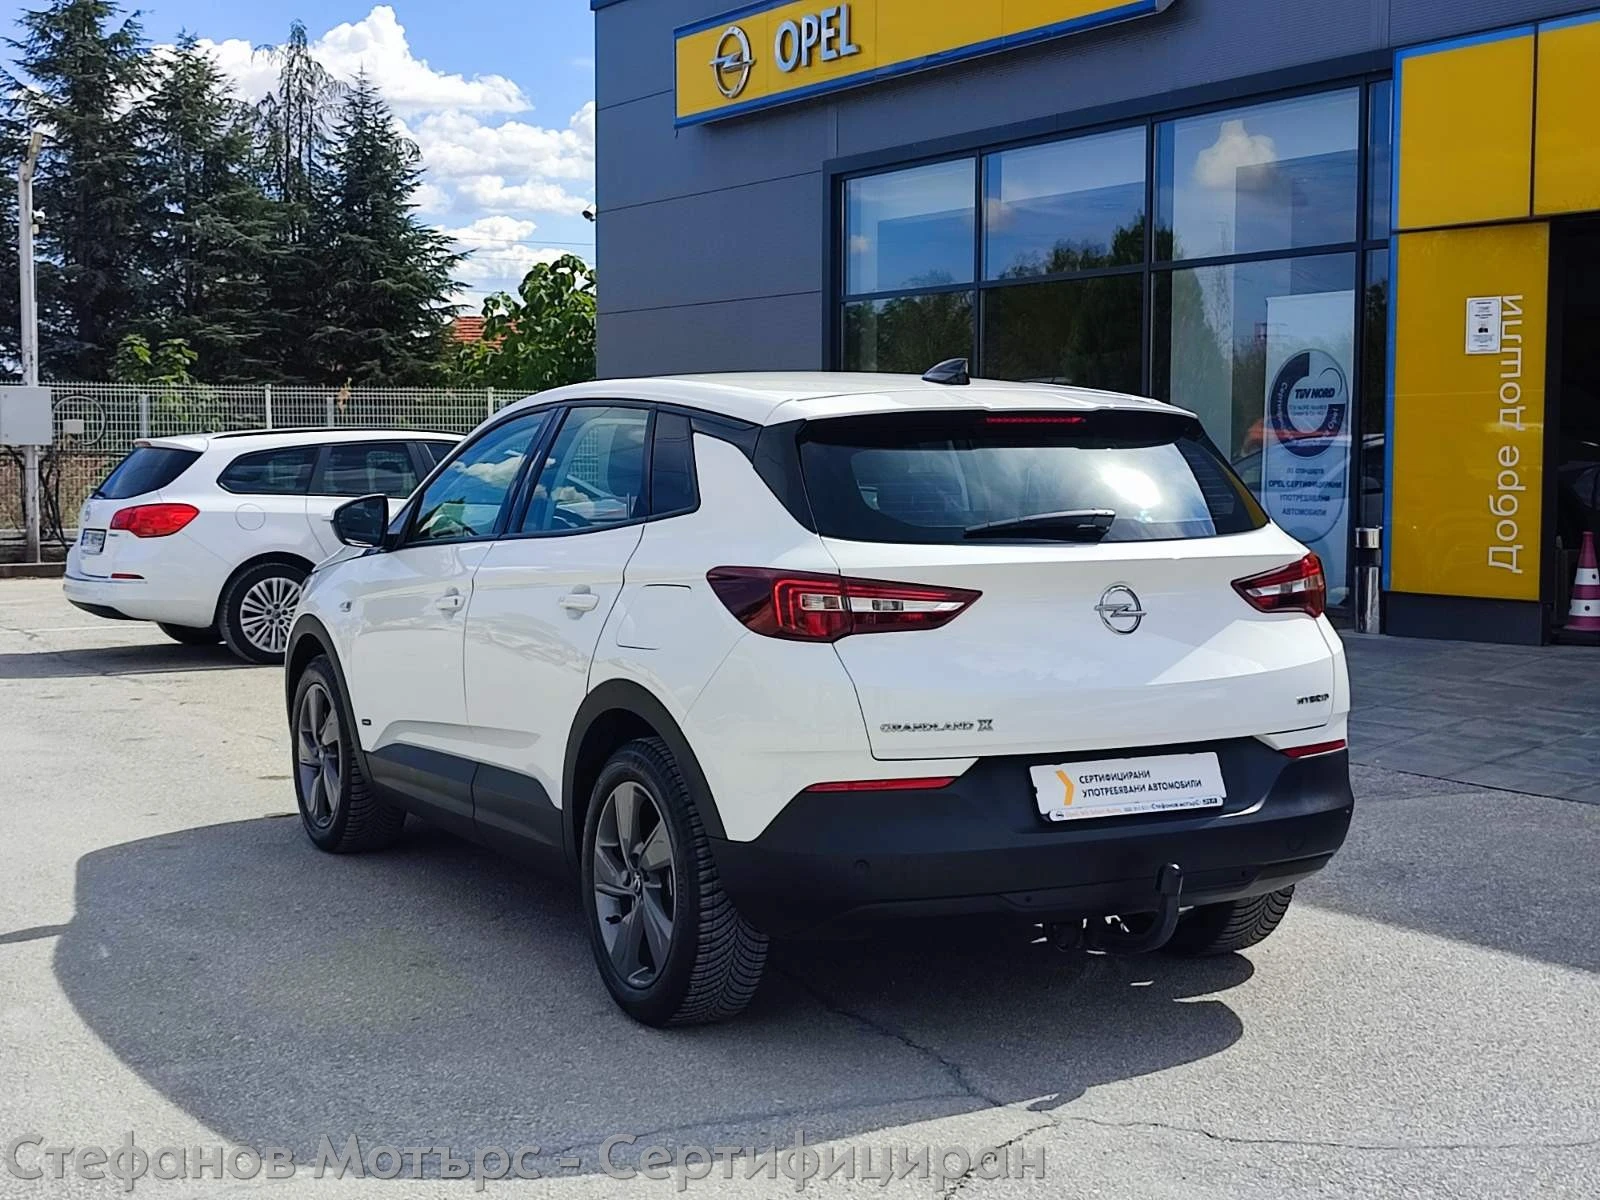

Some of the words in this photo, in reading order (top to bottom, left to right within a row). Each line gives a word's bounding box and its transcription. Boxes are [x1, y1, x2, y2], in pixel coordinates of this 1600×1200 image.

[774, 3, 860, 73] OPEL
[1499, 295, 1526, 431] дошли
[1311, 387, 1336, 399] NORD
[1488, 445, 1526, 574] Добре
[977, 719, 994, 732] X
[1079, 770, 1151, 784] СЕРТИФИЦИРАНИ
[1082, 784, 1147, 798] УПОТРЕБЯВАНИ
[1148, 779, 1202, 792] АВТОМОБИЛИ
